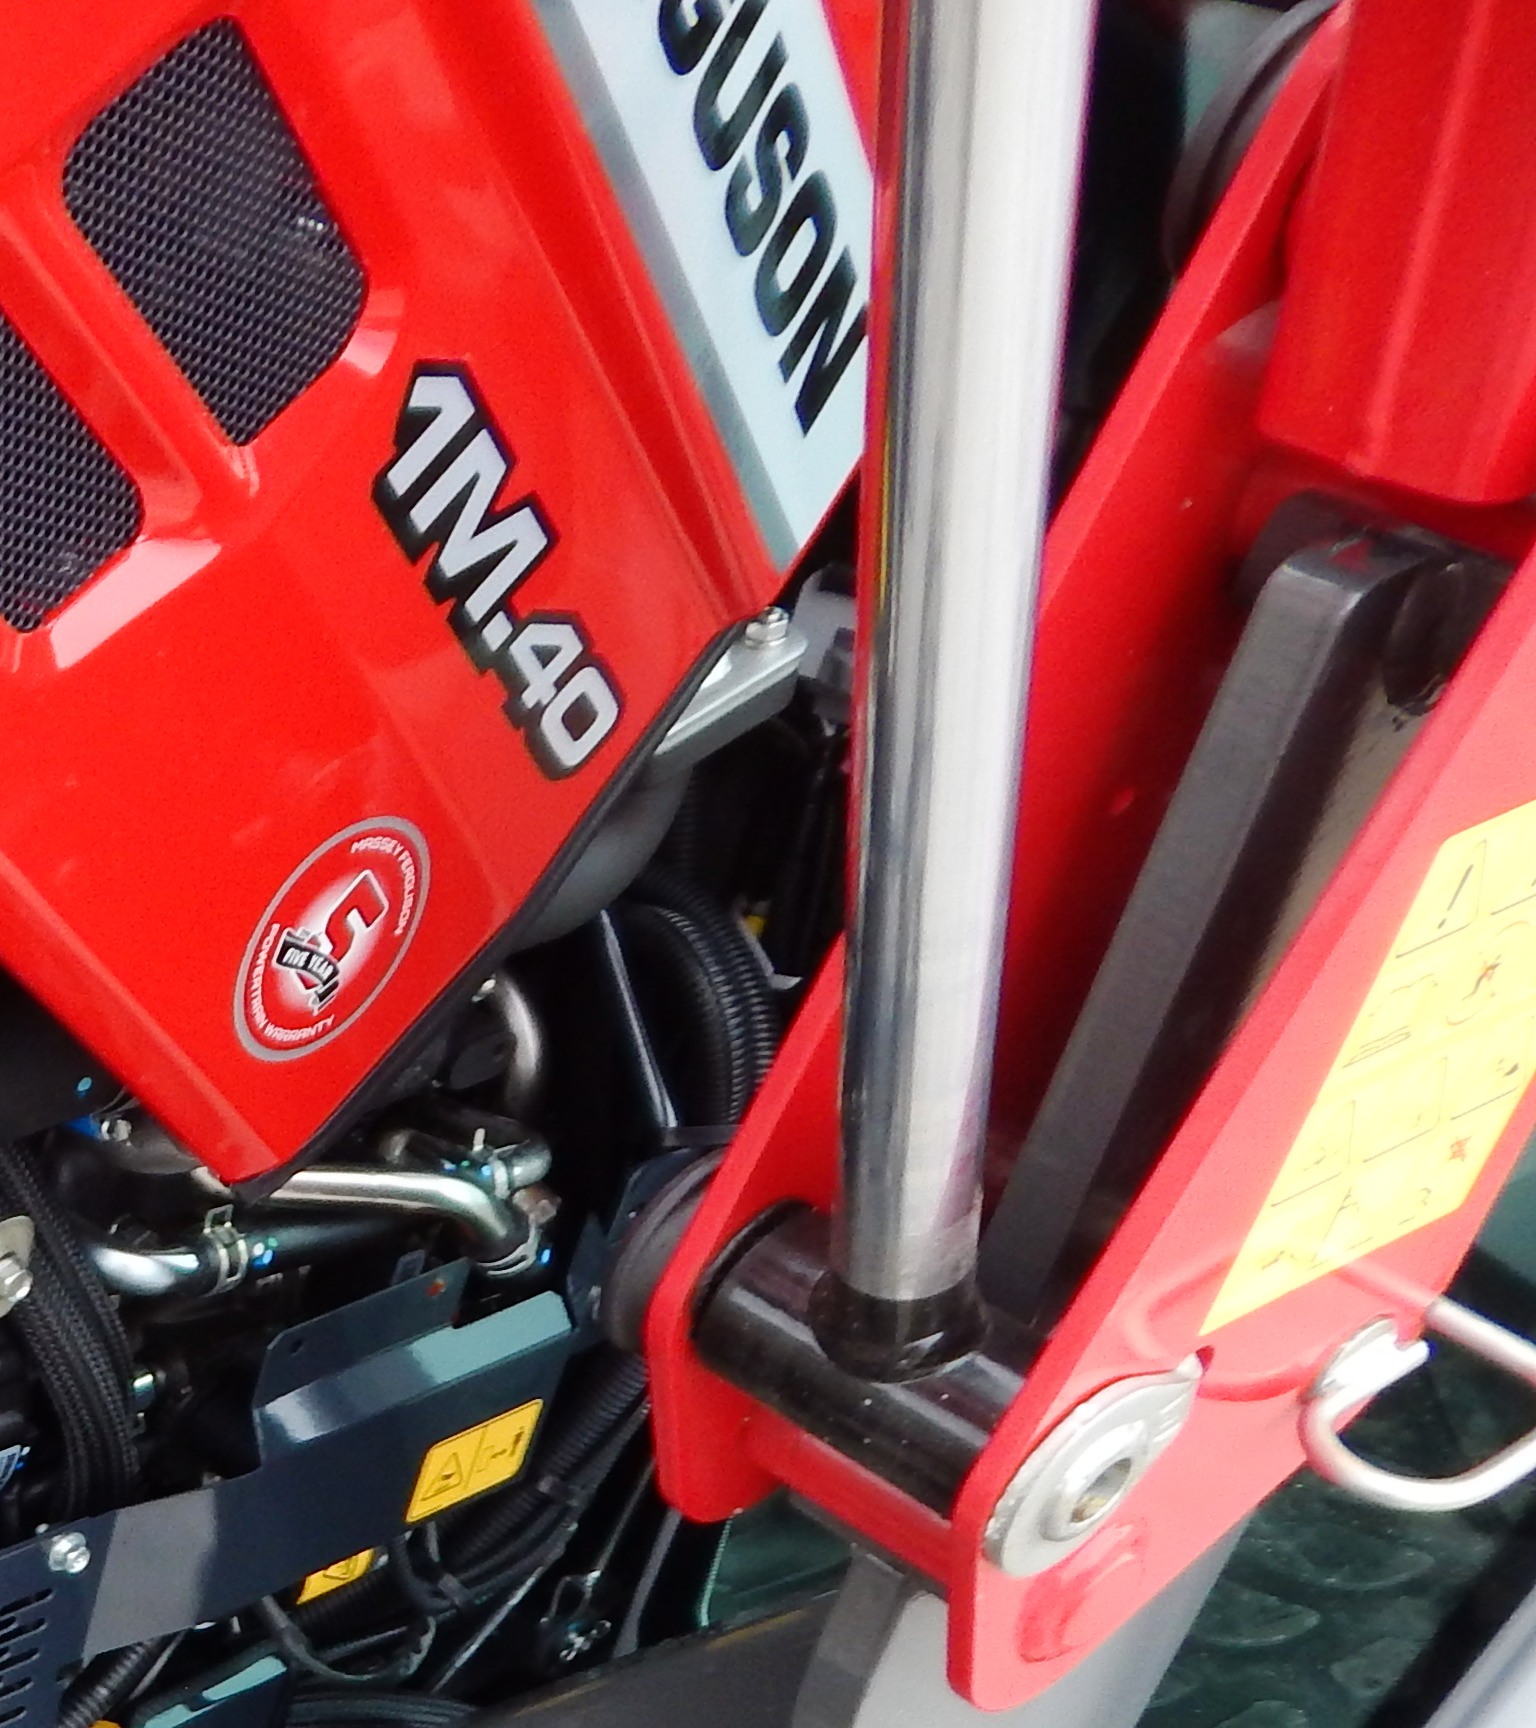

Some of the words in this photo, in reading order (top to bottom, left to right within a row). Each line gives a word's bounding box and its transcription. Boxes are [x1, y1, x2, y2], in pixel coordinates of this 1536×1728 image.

[384, 372, 621, 769] 1M.40
[351, 836, 403, 854] MASSEY
[394, 850, 415, 936] FERGUSON
[250, 923, 281, 1029] POWERTRAIN
[283, 947, 306, 967] FIVE
[307, 954, 334, 979] YEAR
[264, 1014, 335, 1042] WARRANTY
